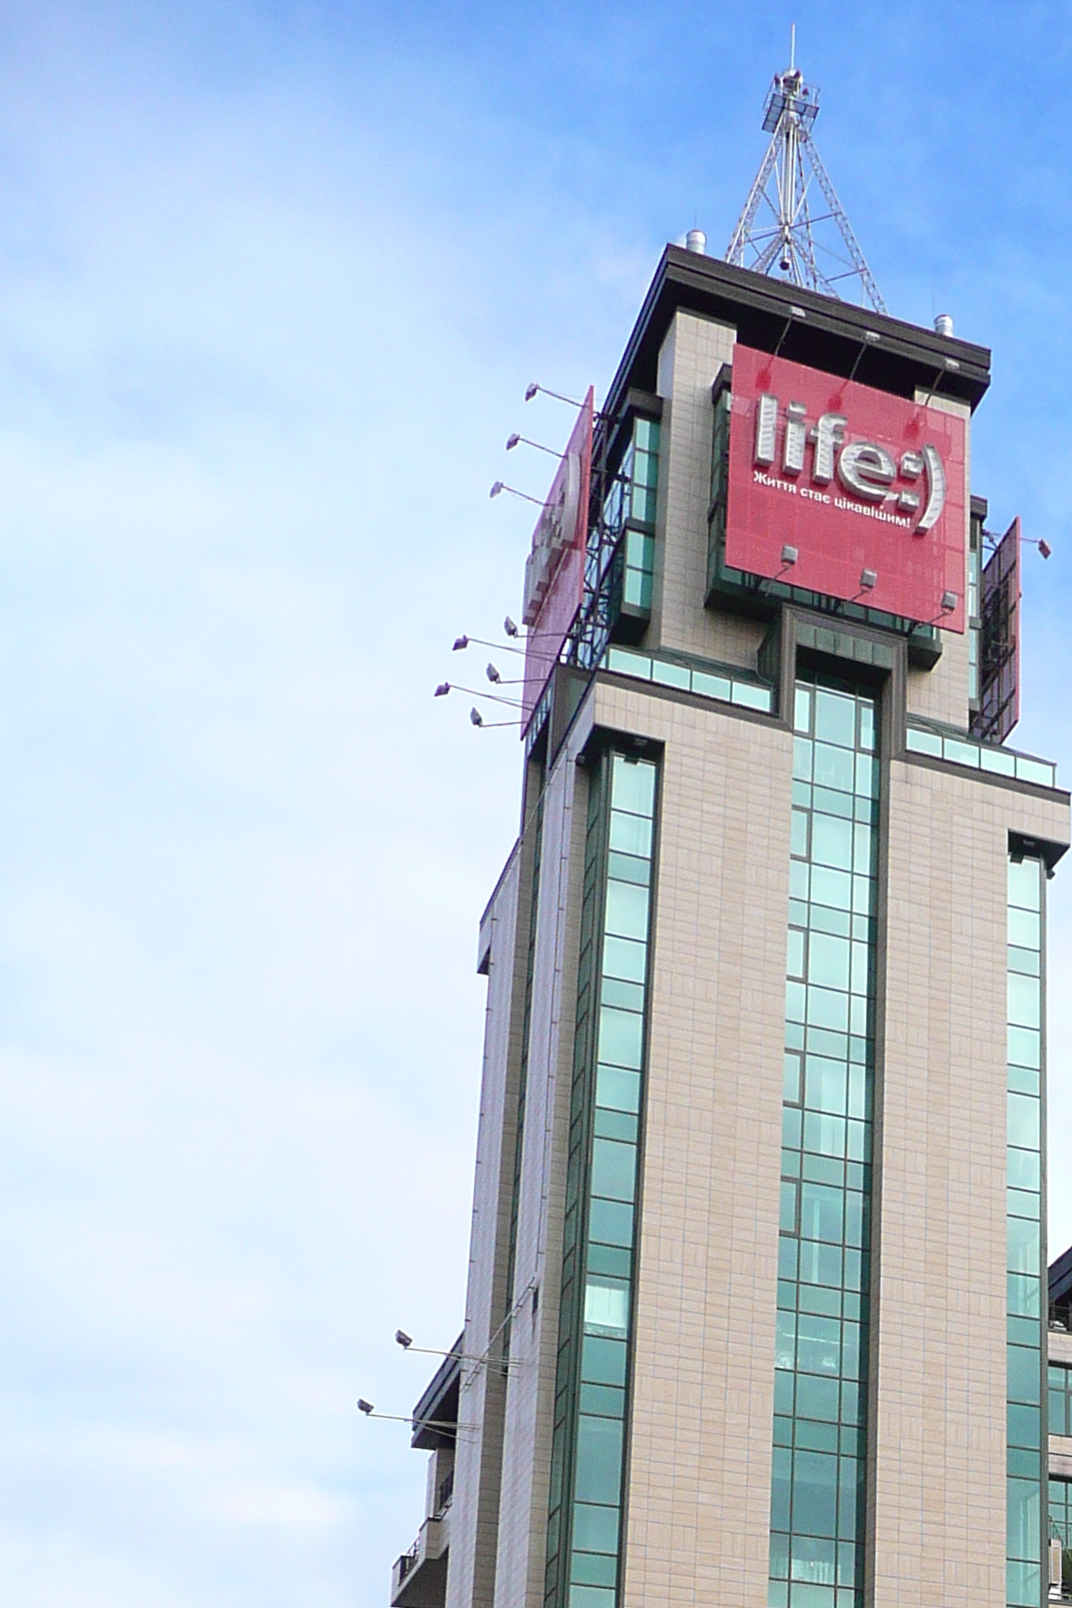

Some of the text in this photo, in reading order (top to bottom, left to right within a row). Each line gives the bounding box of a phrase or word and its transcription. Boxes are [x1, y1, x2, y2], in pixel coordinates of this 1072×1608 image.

[753, 470, 912, 529] Життя стає цікавішим!
[754, 393, 947, 536] life:)
